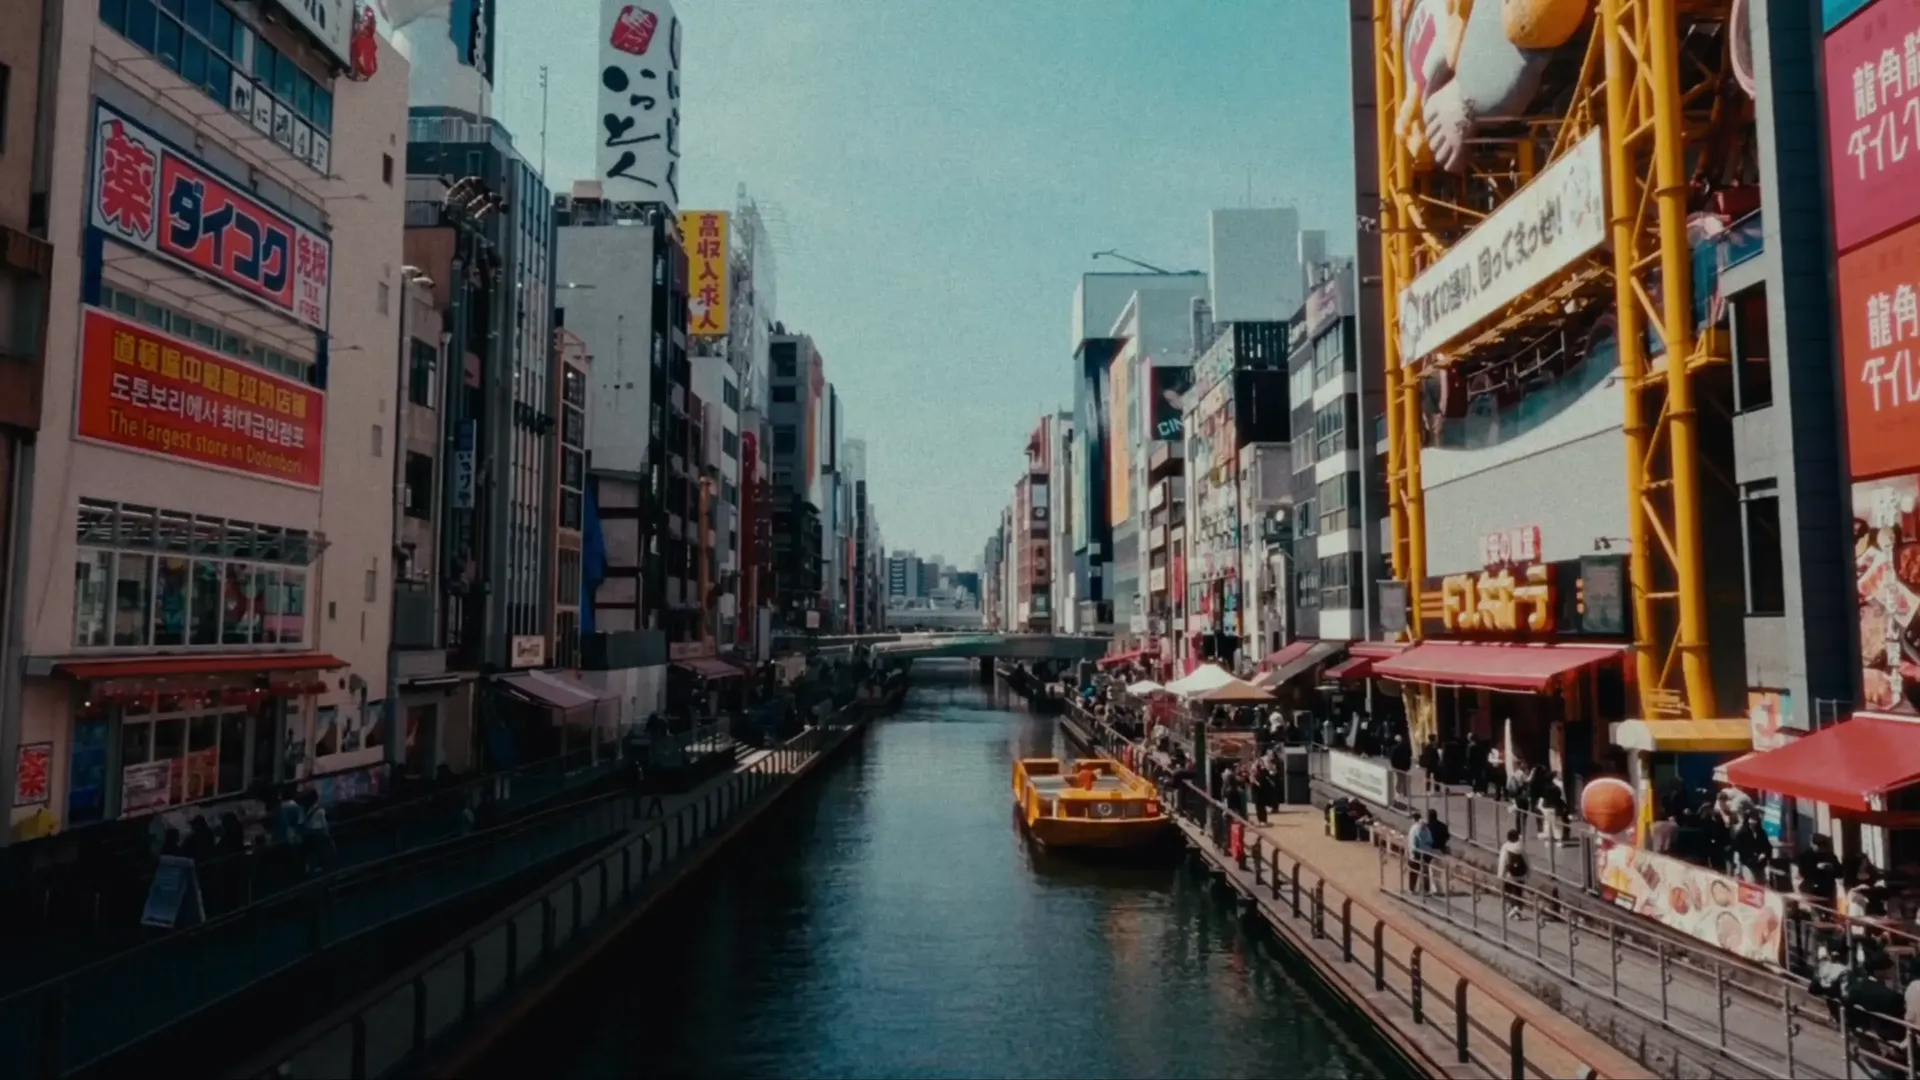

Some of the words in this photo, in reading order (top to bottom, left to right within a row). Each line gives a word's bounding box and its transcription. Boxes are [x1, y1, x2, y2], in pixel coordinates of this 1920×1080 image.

[101, 118, 157, 240] 薬
[168, 176, 289, 293] ダイコク
[110, 408, 138, 437] The
[142, 417, 193, 450] largest
[196, 435, 230, 461] store
